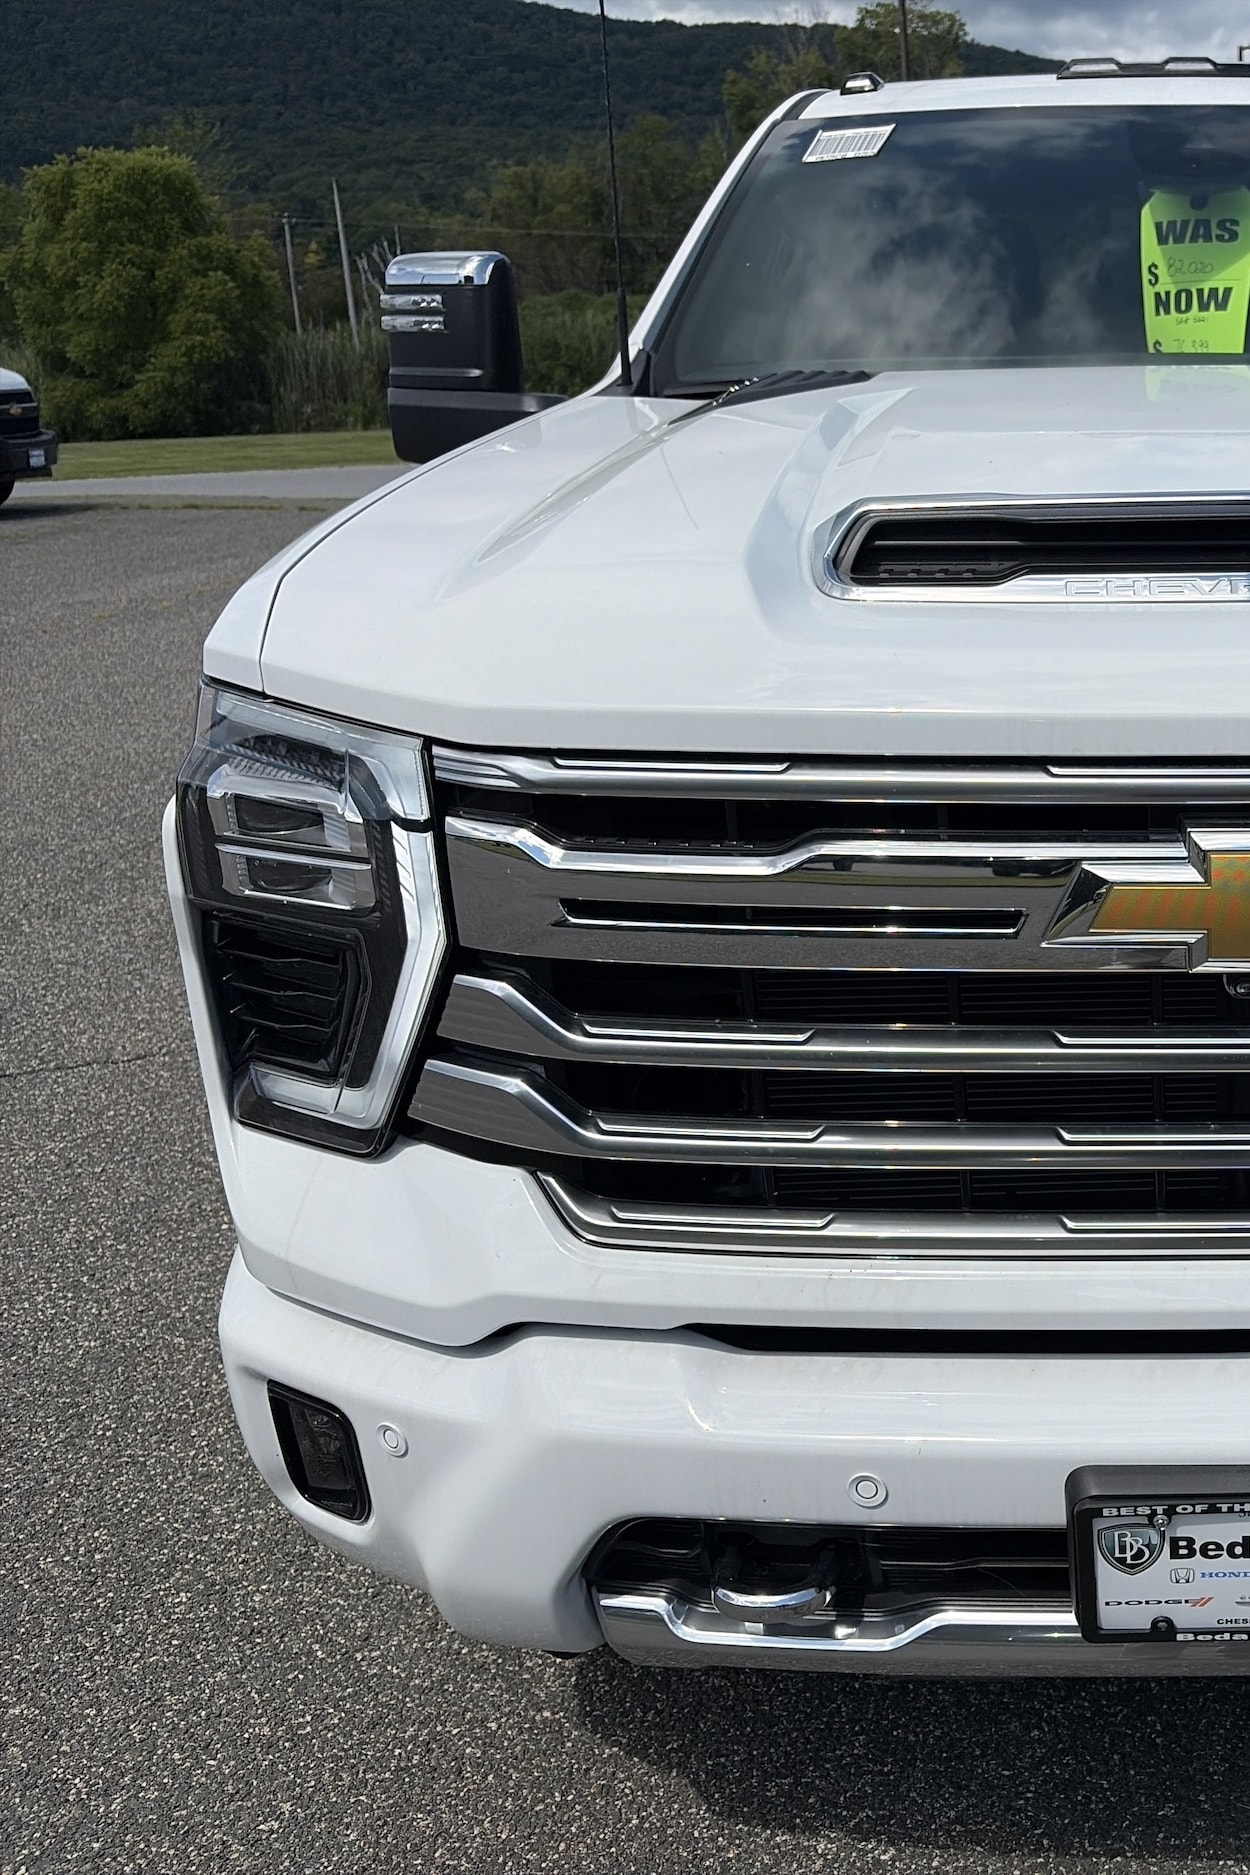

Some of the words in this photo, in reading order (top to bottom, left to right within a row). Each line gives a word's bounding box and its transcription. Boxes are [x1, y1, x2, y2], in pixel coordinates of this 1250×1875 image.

[1155, 218, 1240, 246] WAS
[1148, 262, 1159, 289] $
[1154, 286, 1234, 317] NOW
[1102, 1506, 1168, 1517] BEST
[1175, 1504, 1209, 1513] OF
[1104, 1599, 1195, 1607] DODGE
